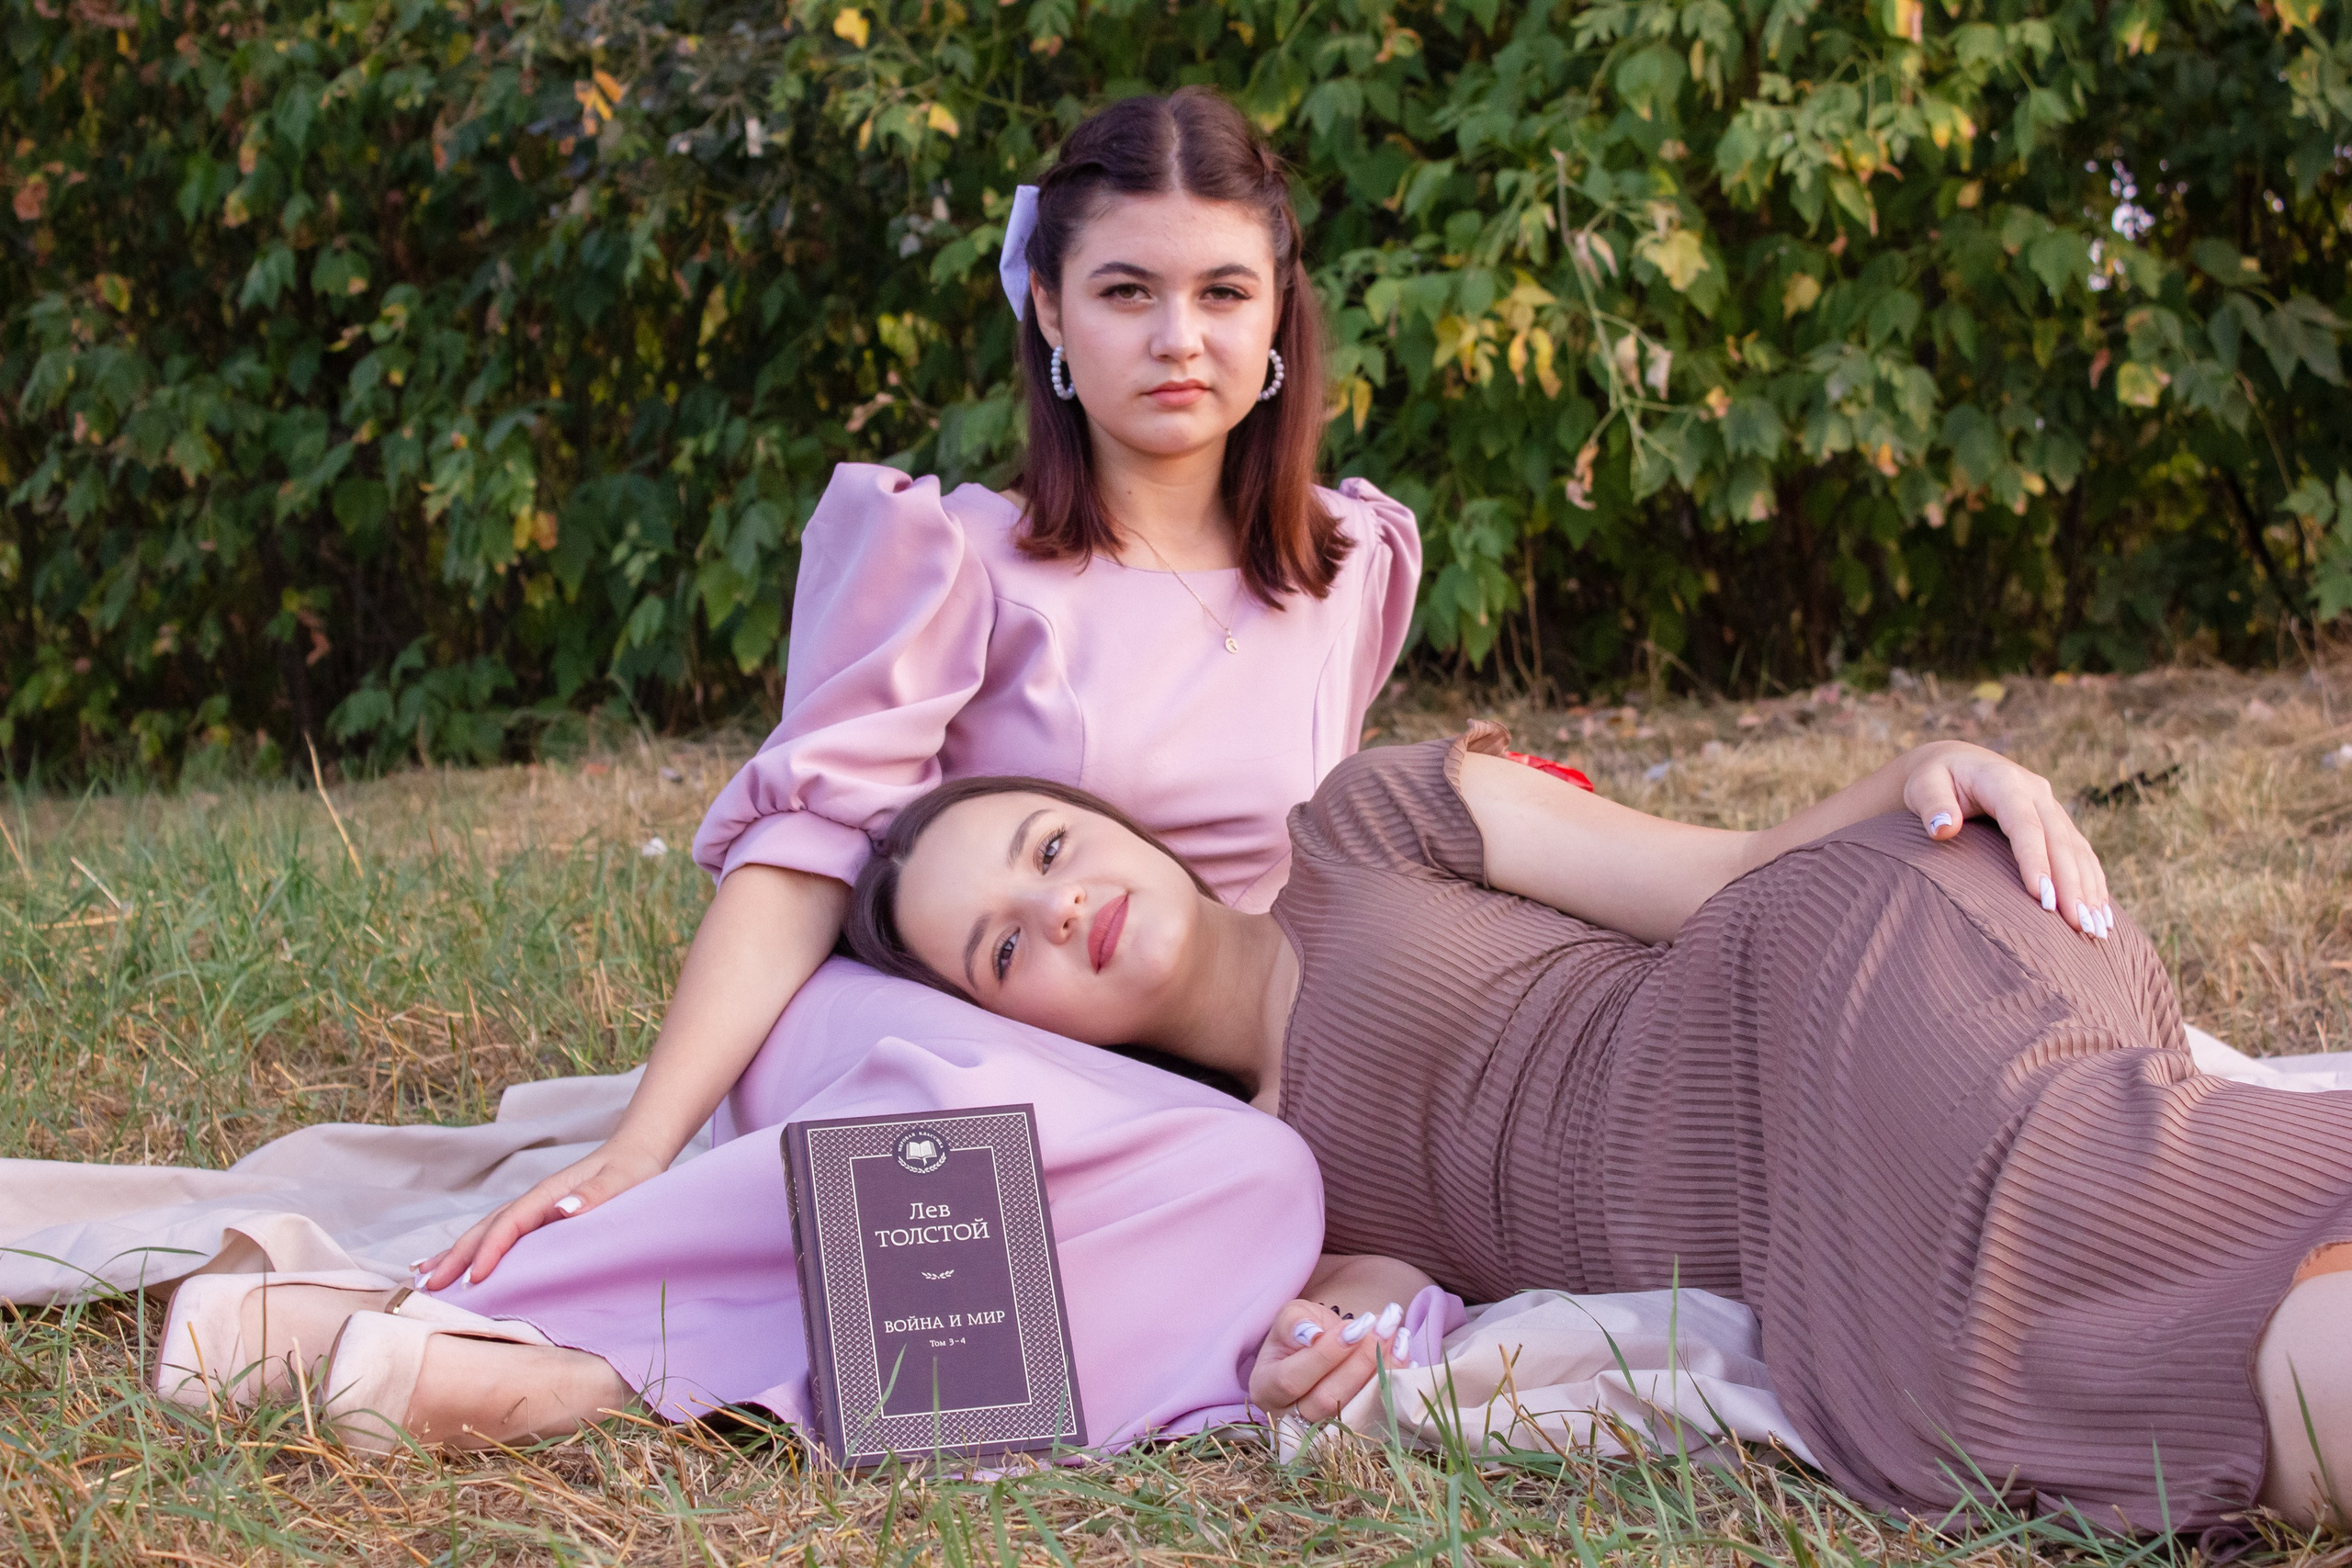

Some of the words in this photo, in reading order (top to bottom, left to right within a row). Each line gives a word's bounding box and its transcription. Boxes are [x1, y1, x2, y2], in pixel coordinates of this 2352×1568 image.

[910, 1202, 951, 1220] Лев
[875, 1217, 990, 1247] ТОЛСТОЙ
[884, 1315, 944, 1333] ВОЙНА
[948, 1314, 962, 1327] И
[967, 1310, 1005, 1325] МИР
[929, 1338, 946, 1348] Том
